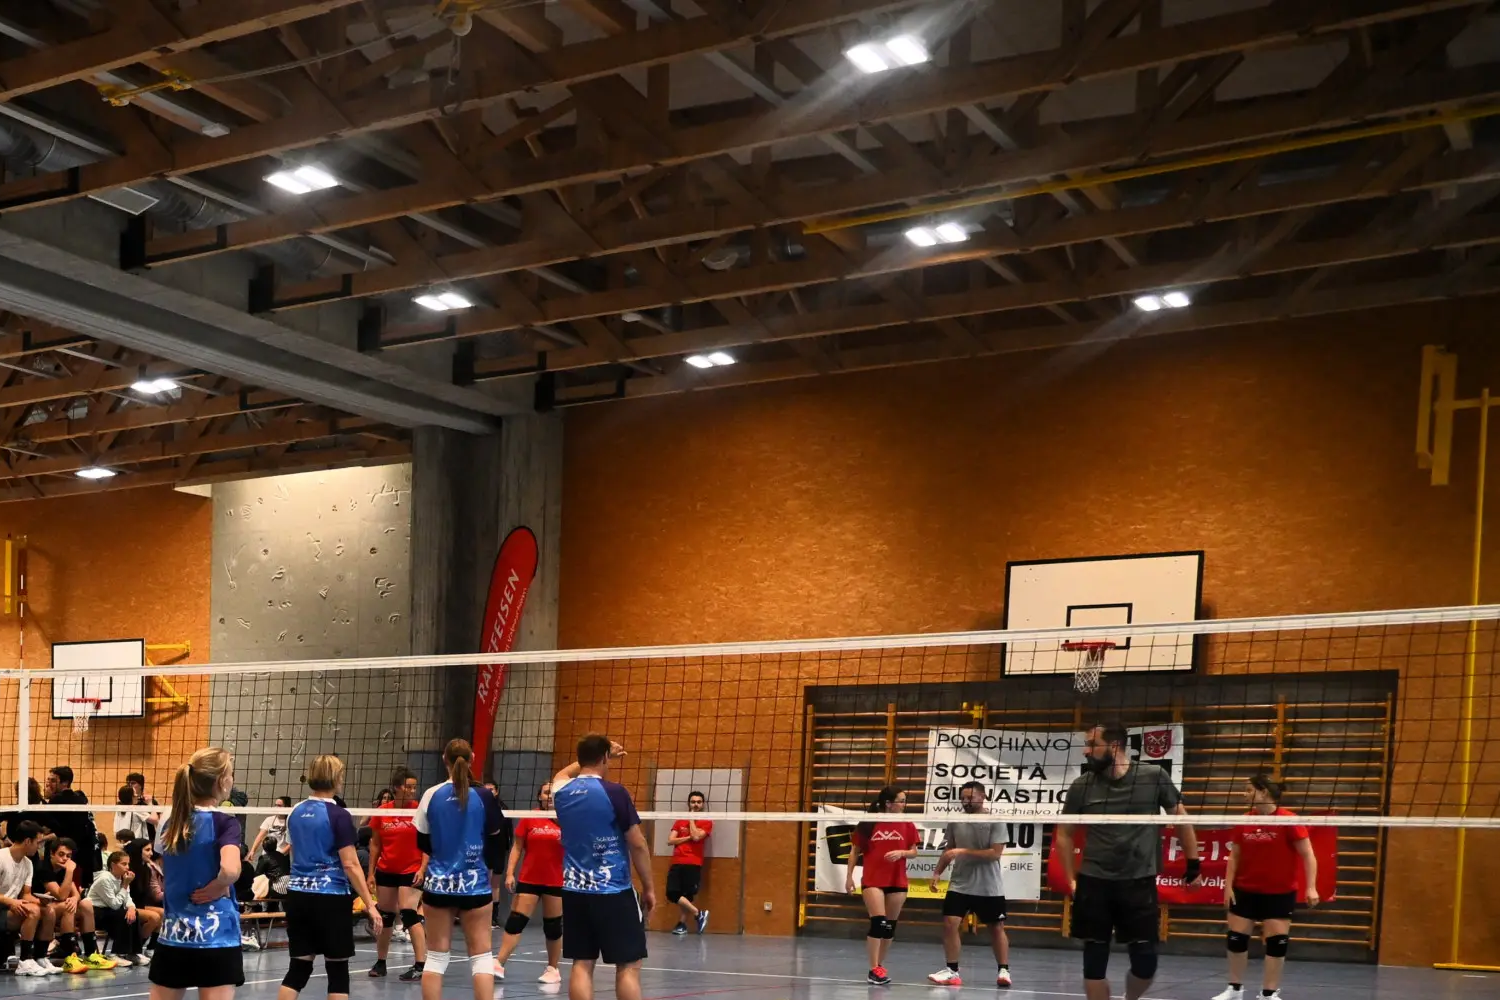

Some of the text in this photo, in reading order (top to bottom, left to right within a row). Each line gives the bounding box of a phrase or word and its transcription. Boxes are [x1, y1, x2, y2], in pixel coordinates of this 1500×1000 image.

[937, 733, 1071, 751] POSCHIAVO
[934, 762, 1047, 781] SOCIETÀ
[933, 786, 1067, 804] GINASTIC
[1009, 862, 1034, 871] BIKE
